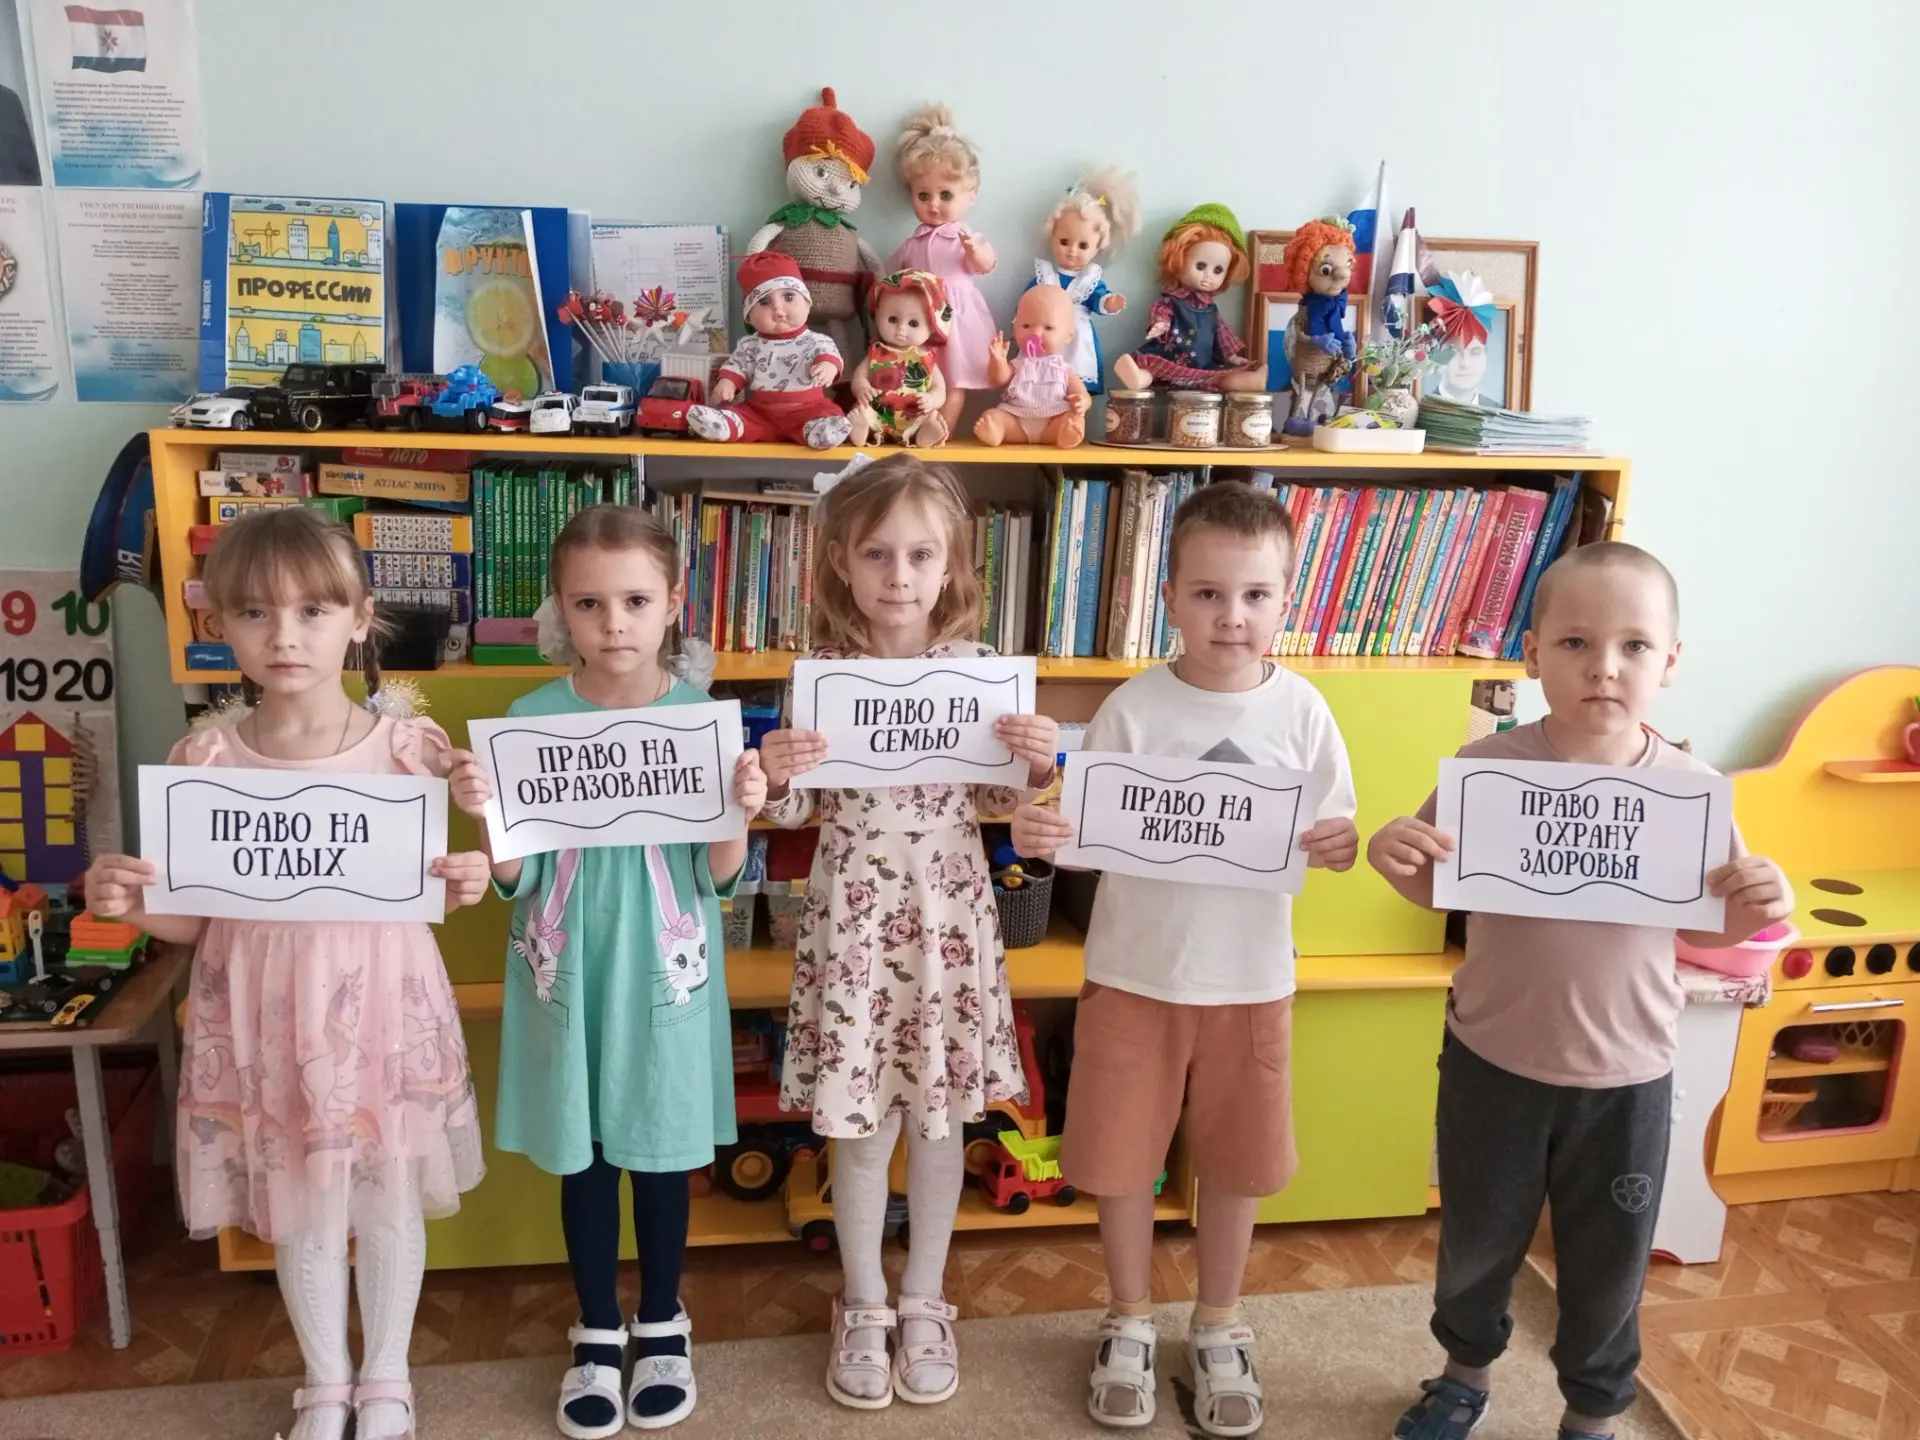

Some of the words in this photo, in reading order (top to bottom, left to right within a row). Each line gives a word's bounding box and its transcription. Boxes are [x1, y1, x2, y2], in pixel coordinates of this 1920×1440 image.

[238, 277, 372, 303] ПРОФЕССИИ
[374, 478, 411, 489] АТЛАС
[413, 480, 446, 492] МИРА
[1, 590, 36, 636] 9
[51, 590, 110, 636] 10
[0, 658, 47, 702] 19
[53, 658, 113, 702] 20
[853, 697, 935, 726] ПРАВО
[948, 696, 979, 723] НА
[537, 742, 627, 773] ПРАВО
[640, 738, 678, 766] НА
[870, 727, 960, 753] СЕМЬЮ
[517, 766, 705, 805] ОБРАЗОВАНИЕ
[1120, 784, 1205, 817] ПРАВО
[1218, 795, 1252, 821] НА
[1520, 790, 1599, 819] ПРАВО
[1612, 796, 1645, 822] НА
[210, 809, 312, 843] ПРАВО
[329, 813, 370, 843] НА
[1140, 816, 1225, 847] ЖИЗНЬ
[1535, 820, 1640, 851] ОХРАНУ
[232, 847, 346, 880] ОТДЫХ
[1519, 848, 1640, 880] ЗДОРОВЬЯ
